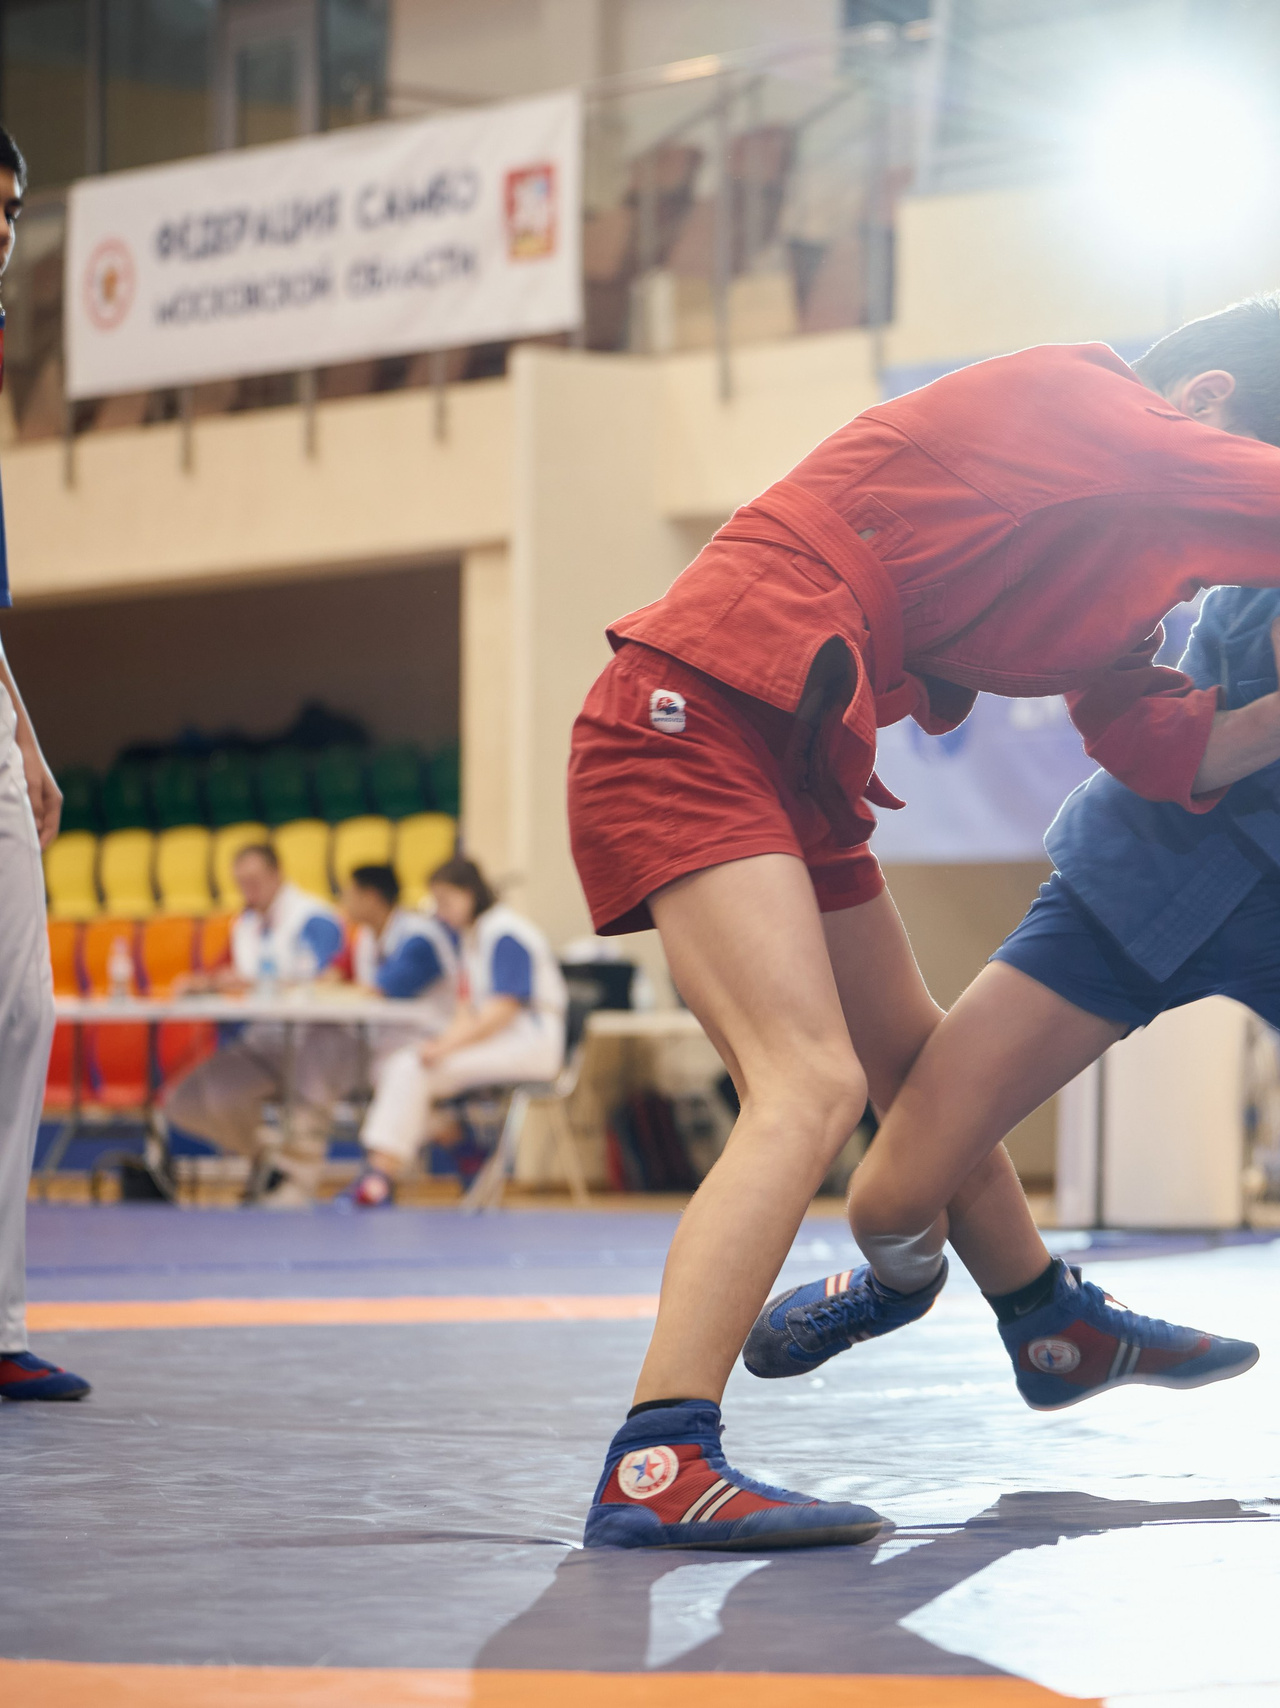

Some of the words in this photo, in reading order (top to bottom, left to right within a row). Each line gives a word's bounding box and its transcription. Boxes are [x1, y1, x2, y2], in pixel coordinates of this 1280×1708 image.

[153, 189, 341, 262] ФЕДЕРАЦИЯ
[354, 166, 481, 231] САМБО
[154, 266, 334, 326] МОСКОВСКОЙ
[347, 245, 478, 293] ОБЛАСТИ
